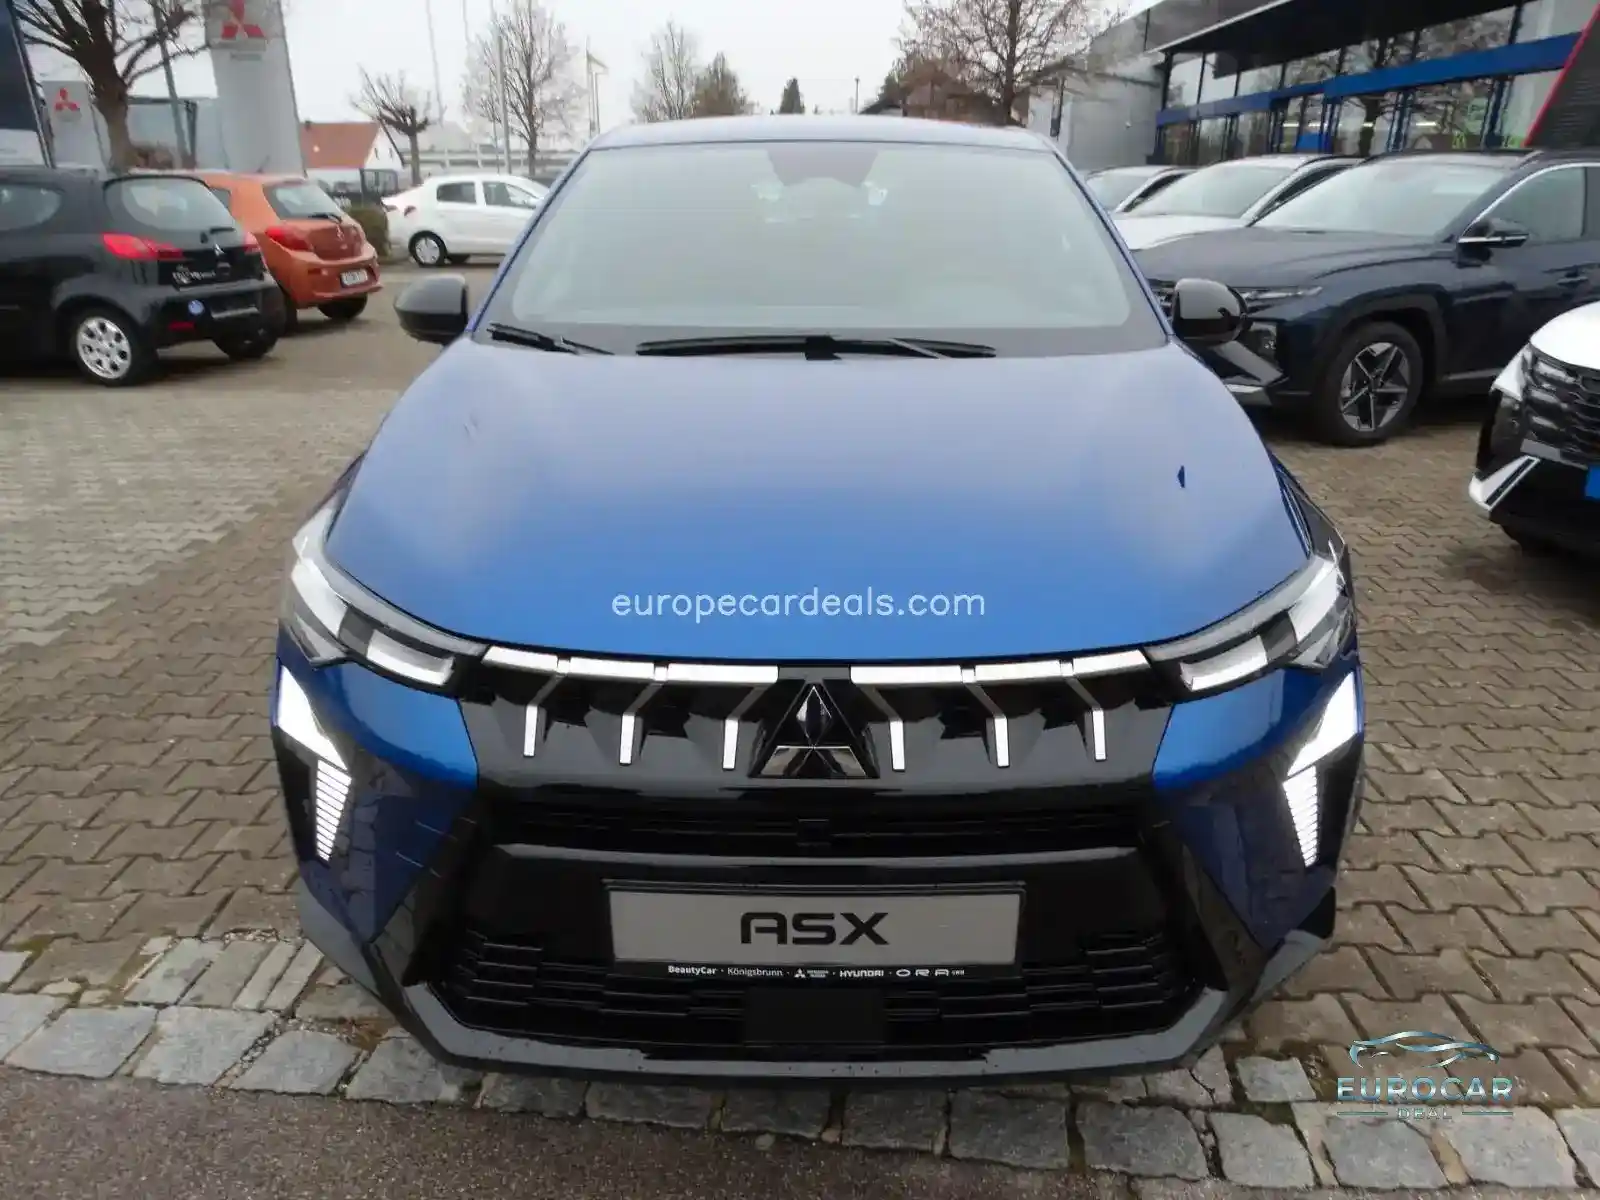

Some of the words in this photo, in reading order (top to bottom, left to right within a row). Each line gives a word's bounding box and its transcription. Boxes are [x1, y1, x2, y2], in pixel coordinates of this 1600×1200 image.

[740, 912, 889, 946] ASX
[667, 965, 717, 976] BeautyCar
[727, 967, 783, 977] Königsbrunn
[839, 969, 884, 978] HYUNDAI
